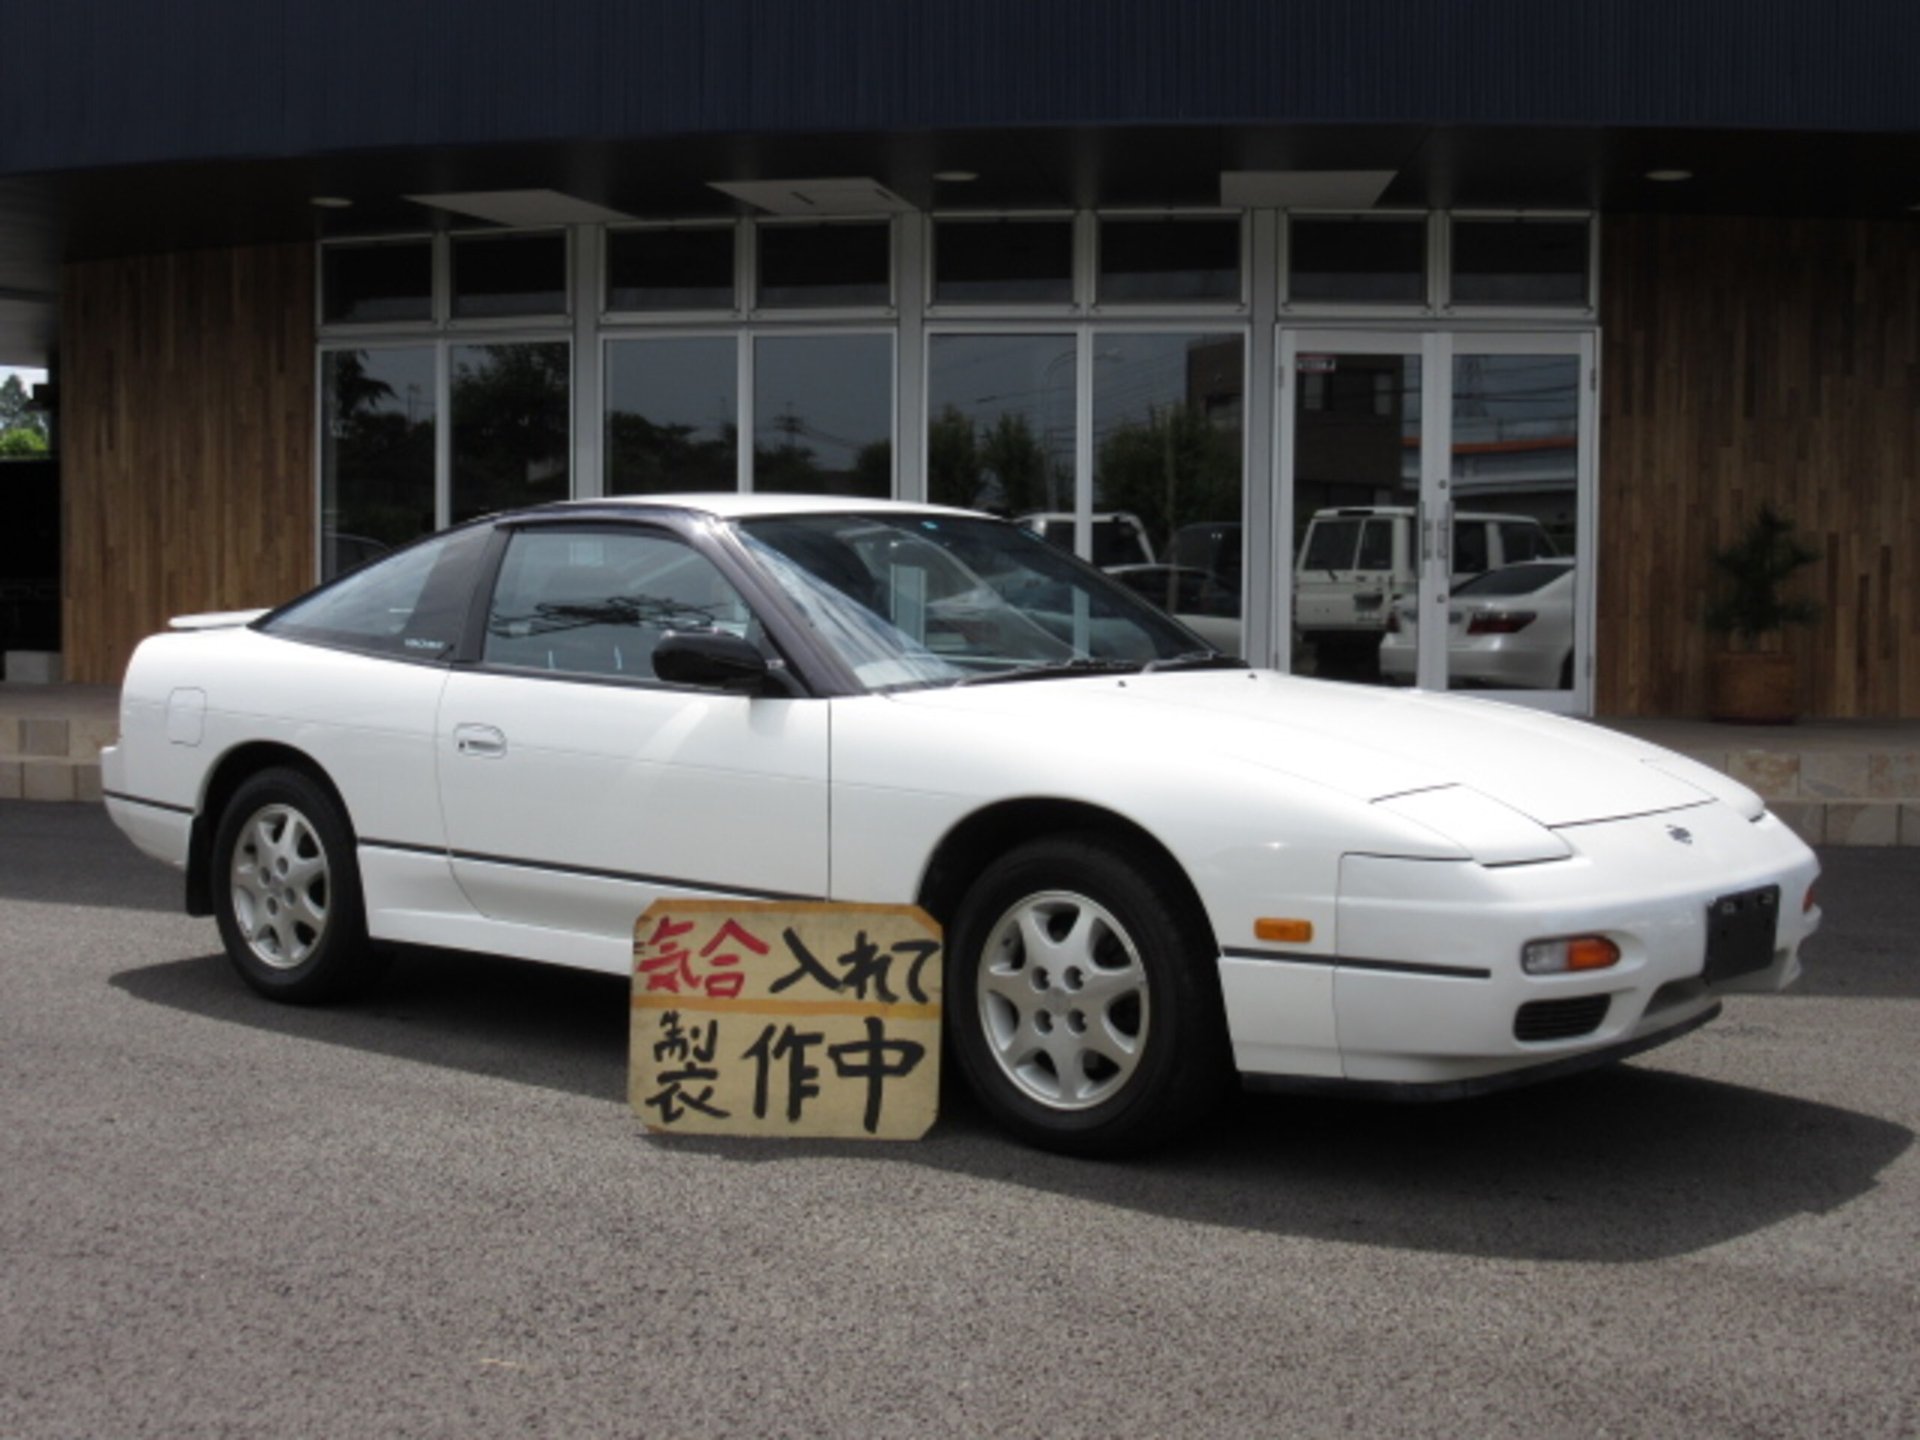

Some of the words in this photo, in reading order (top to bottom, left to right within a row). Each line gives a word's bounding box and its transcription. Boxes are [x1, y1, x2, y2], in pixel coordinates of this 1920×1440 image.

[637, 915, 942, 1004] 気合入れて
[645, 1010, 926, 1134] 製作中
